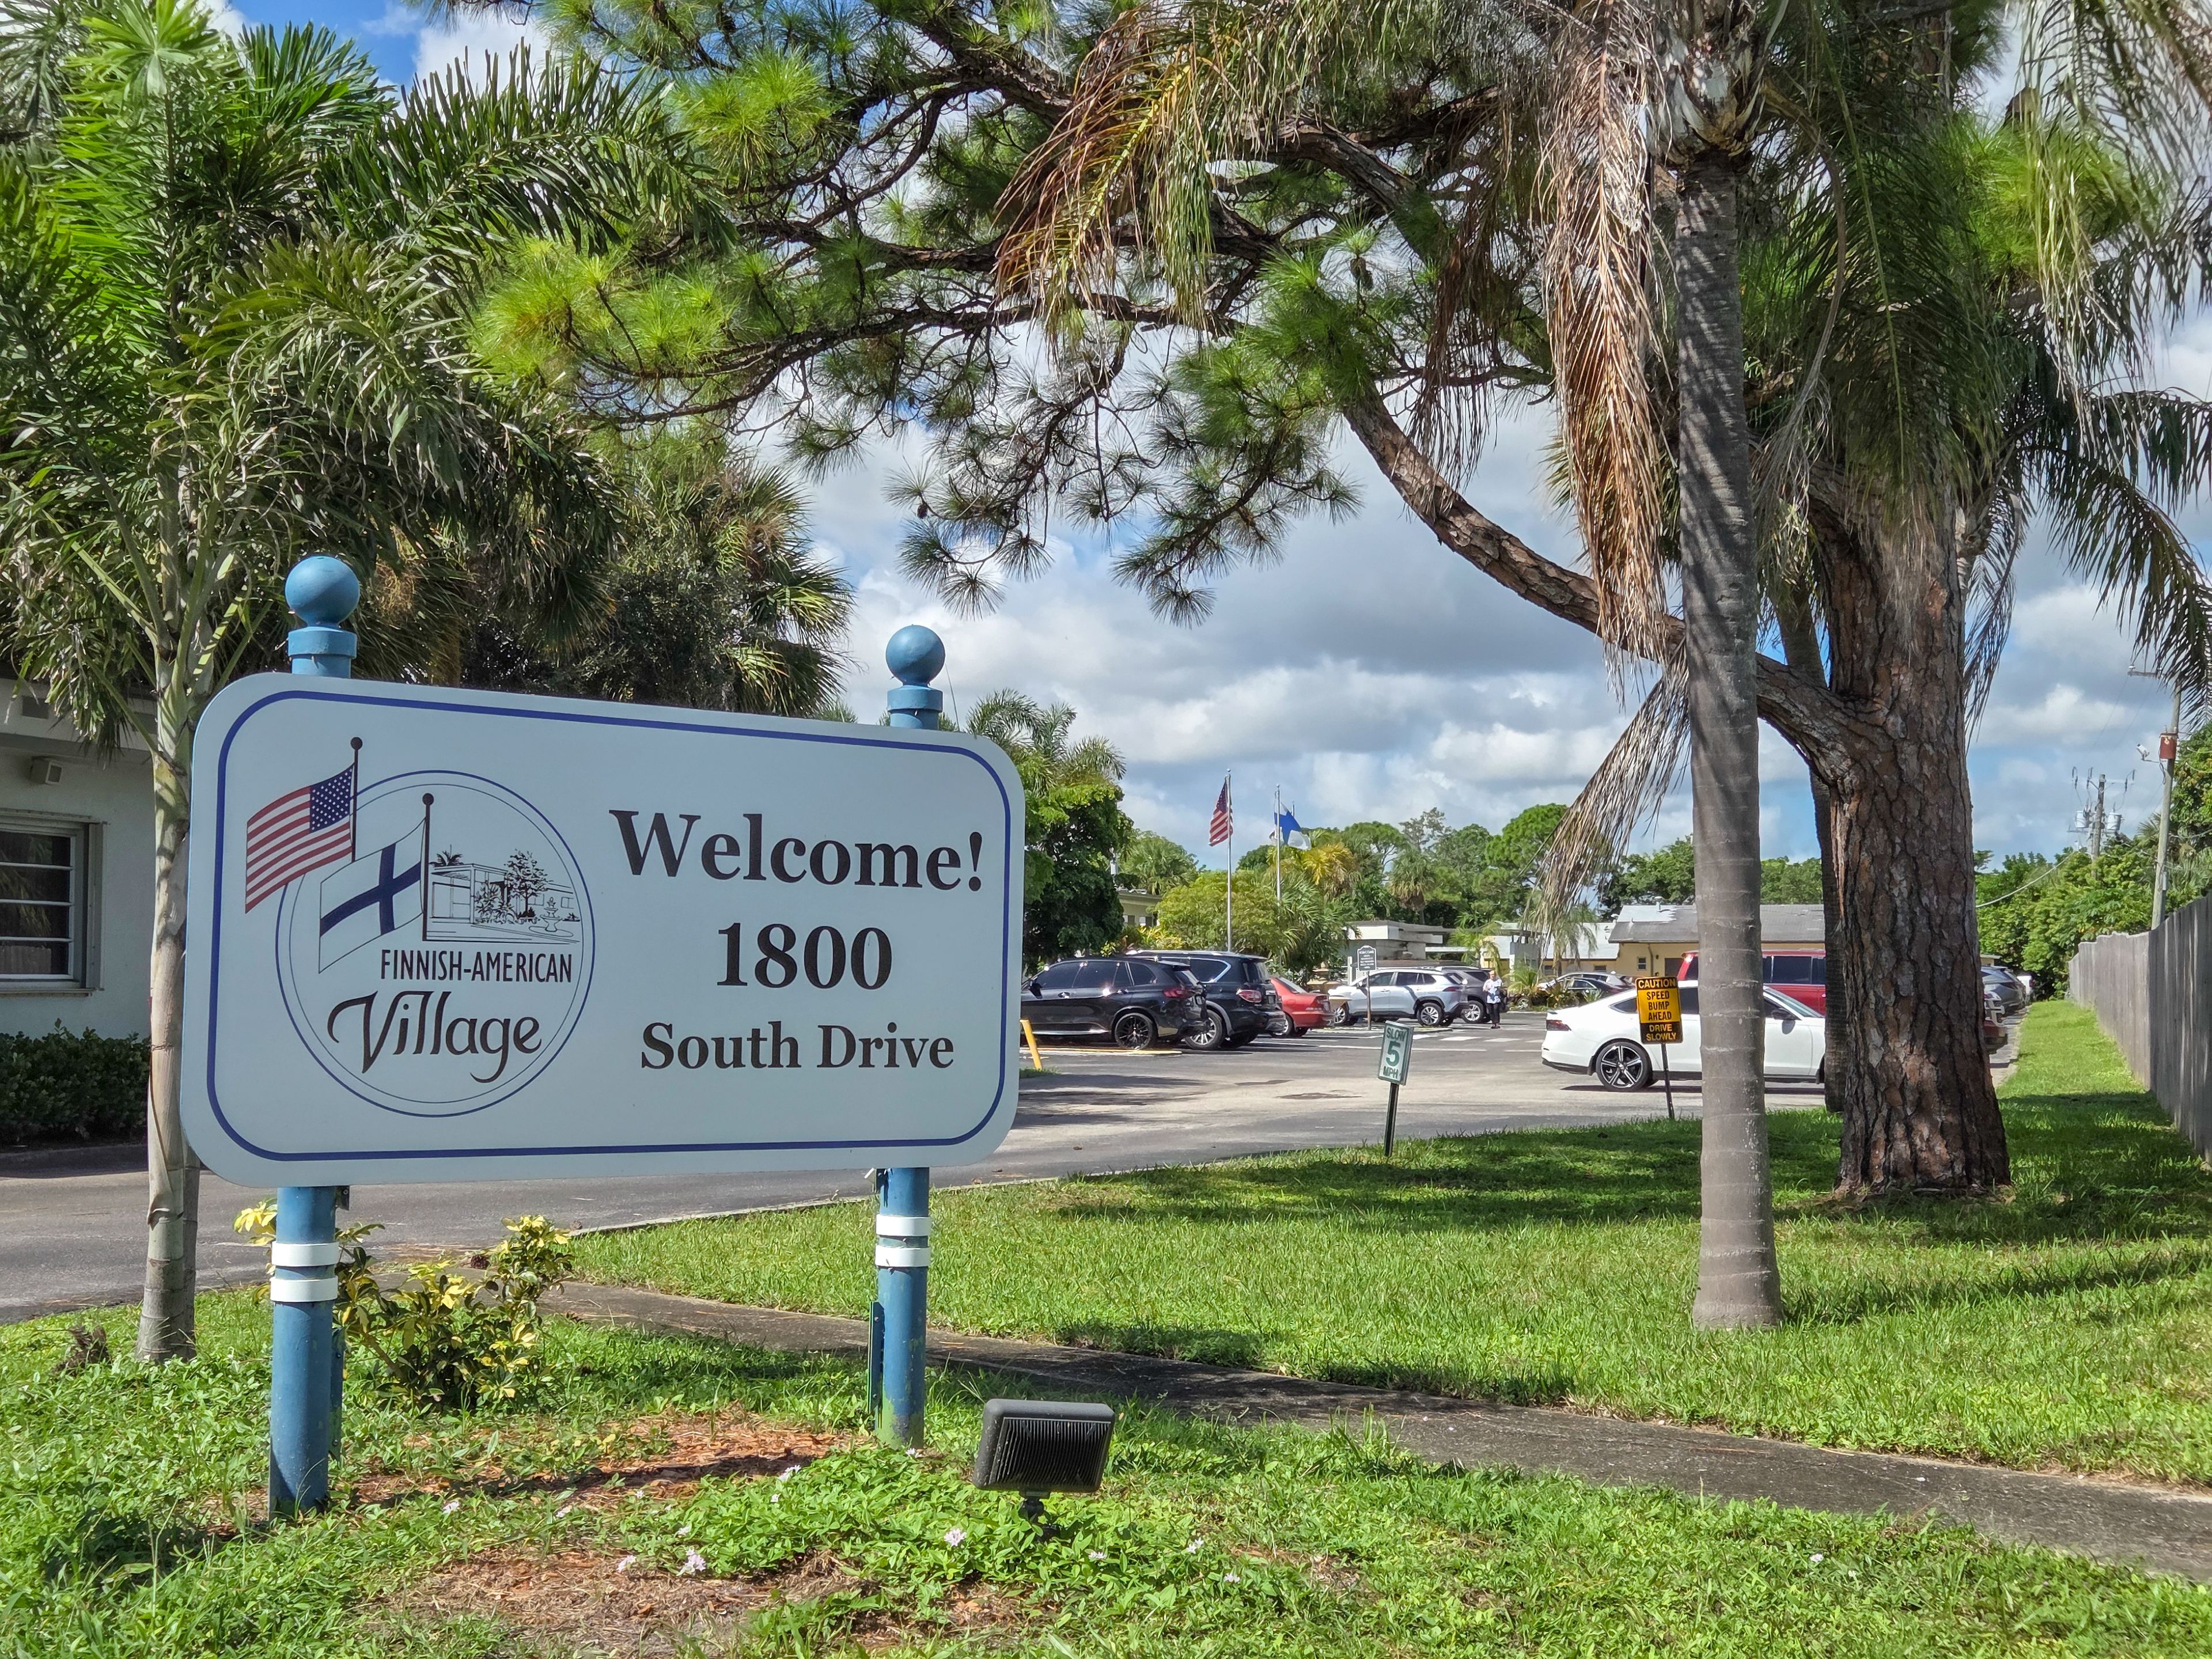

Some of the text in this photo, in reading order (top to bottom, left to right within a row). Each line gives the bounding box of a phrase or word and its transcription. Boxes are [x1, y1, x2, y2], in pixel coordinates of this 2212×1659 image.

[608, 809, 983, 892] Welcome!
[717, 922, 892, 990] 1800
[381, 949, 572, 983] FINNISH-AMERICAN
[1638, 979, 1676, 988] CAUTION
[1646, 991, 1669, 1000] SPEED
[1648, 1001, 1669, 1010] BUMP
[1648, 1012, 1672, 1021] AHEAD
[1386, 1027, 1406, 1041] SLOW
[1649, 1024, 1672, 1032] DRIVE
[328, 990, 541, 1084] Village
[1646, 1033, 1676, 1041] SLOWLY
[641, 1020, 954, 1070] South Drive
[1385, 1040, 1401, 1066] 5
[1383, 1066, 1398, 1078] MPH
